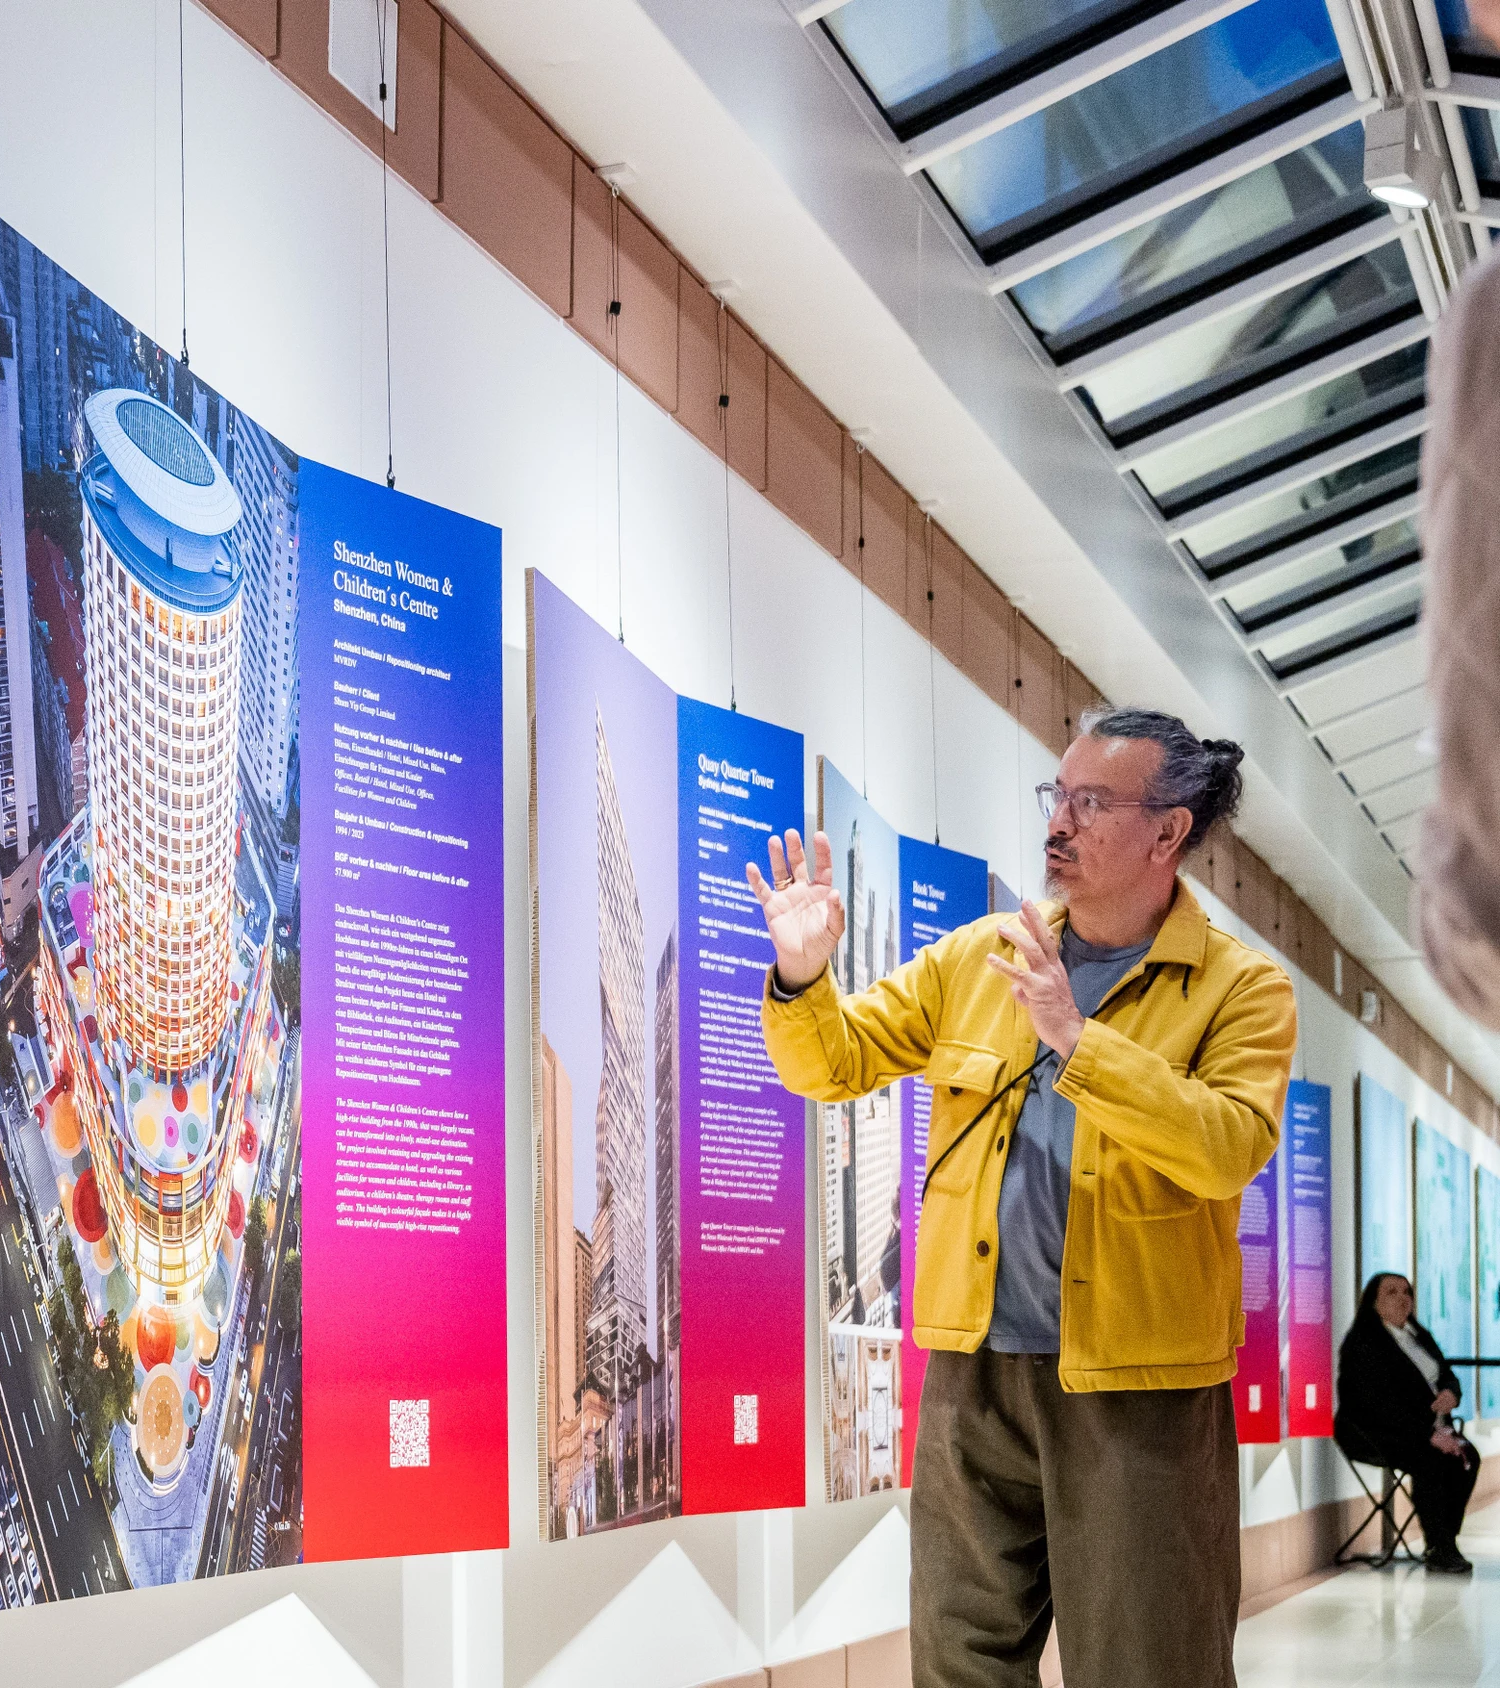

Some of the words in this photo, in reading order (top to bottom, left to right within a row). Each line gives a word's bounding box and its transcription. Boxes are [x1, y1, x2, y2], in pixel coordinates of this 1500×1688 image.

[334, 540, 392, 577] Shenzhen
[394, 560, 439, 592] Women
[442, 577, 453, 597] &
[334, 598, 379, 626] Shenzhen,
[380, 613, 406, 632] China
[399, 591, 438, 620] Centre
[333, 639, 361, 655] Architekt
[361, 646, 383, 661] Umbau
[386, 654, 426, 675] Repositioning
[426, 667, 451, 681] architect
[334, 680, 358, 696] Bauherr
[362, 688, 380, 702] Client
[698, 753, 719, 776] Quay
[720, 760, 750, 782] Quarter
[750, 769, 774, 789] Tower
